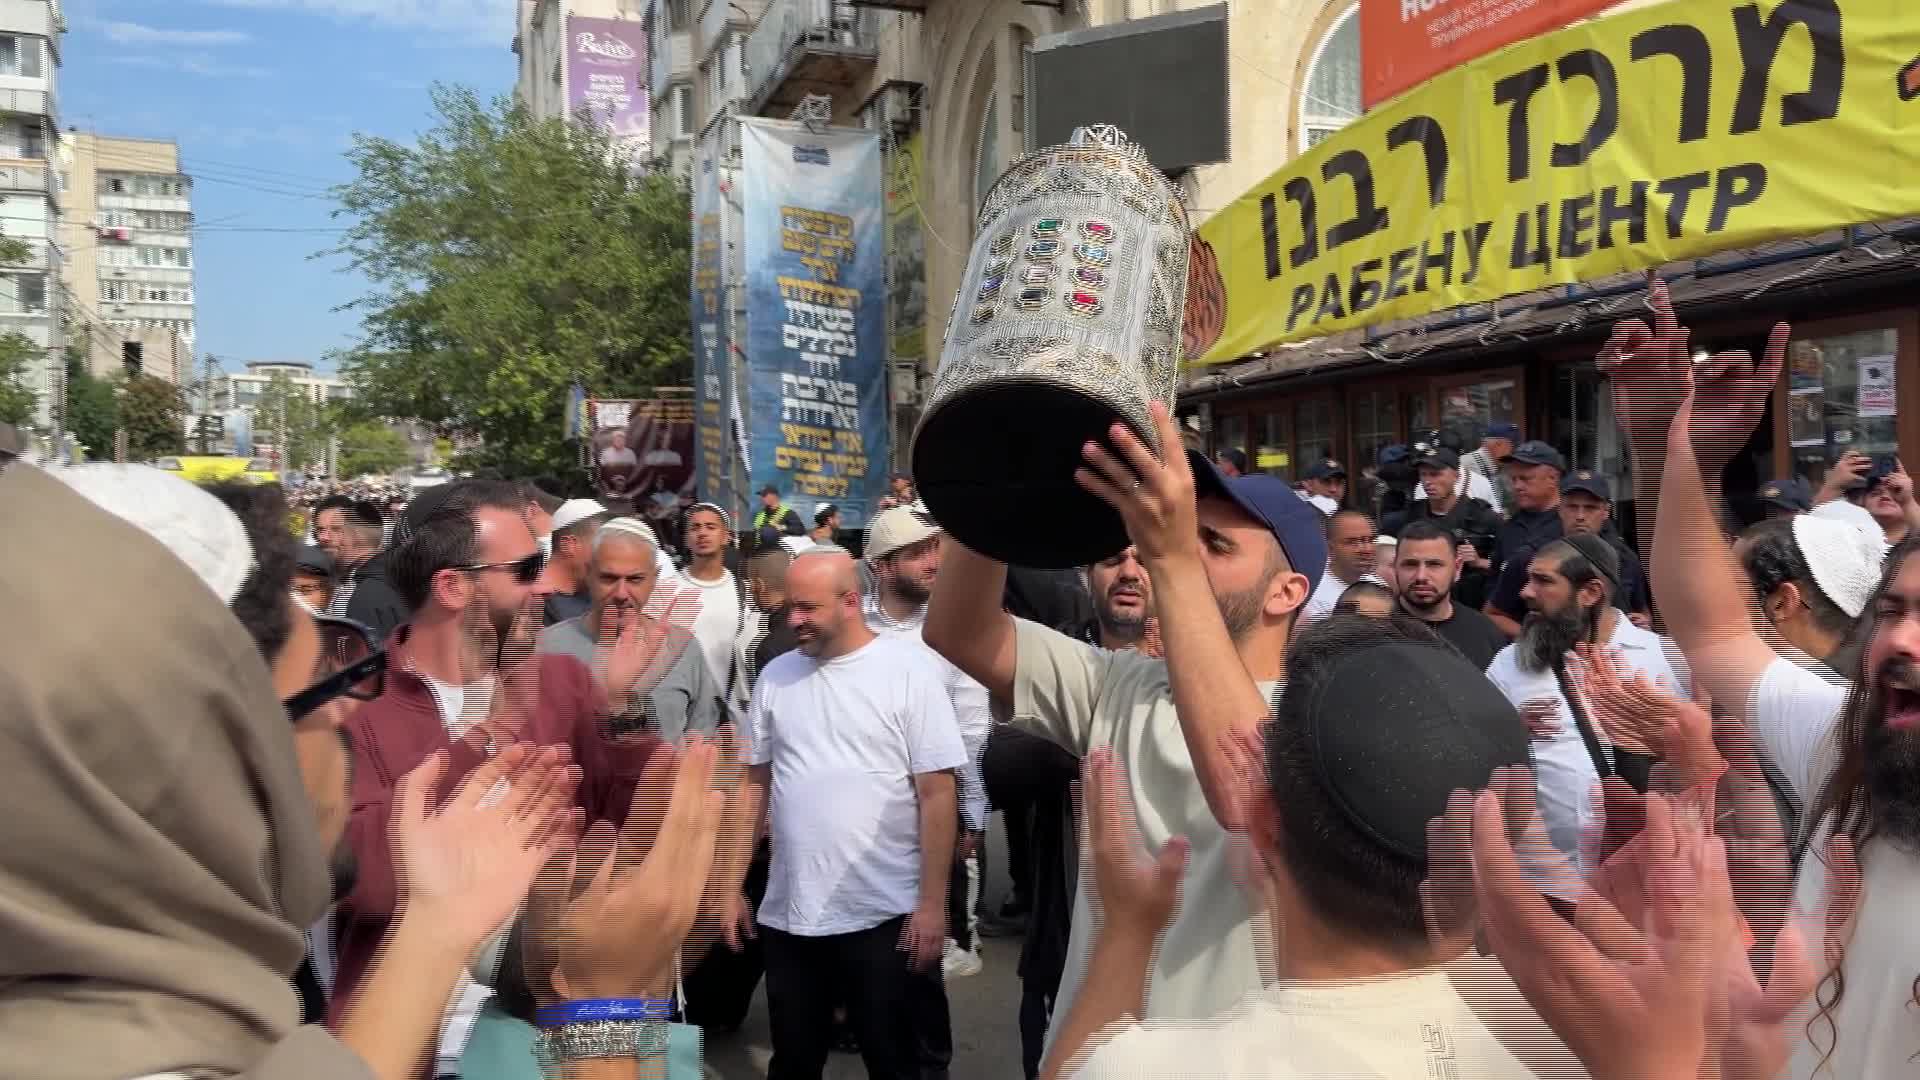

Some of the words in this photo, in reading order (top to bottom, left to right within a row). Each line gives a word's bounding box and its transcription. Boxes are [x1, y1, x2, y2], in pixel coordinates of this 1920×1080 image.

[1426, 7, 1462, 34] НЕХАЙ
[1494, 0, 1845, 184] מרכז
[1260, 116, 1450, 283] רבנו
[1286, 222, 1493, 334] РАБЕНУ
[1511, 163, 1768, 273] ЦЕНТР
[782, 323, 858, 358] נכללים
[800, 352, 841, 377] יחד
[782, 373, 859, 406] באהבה
[782, 398, 861, 432] ואחדות
